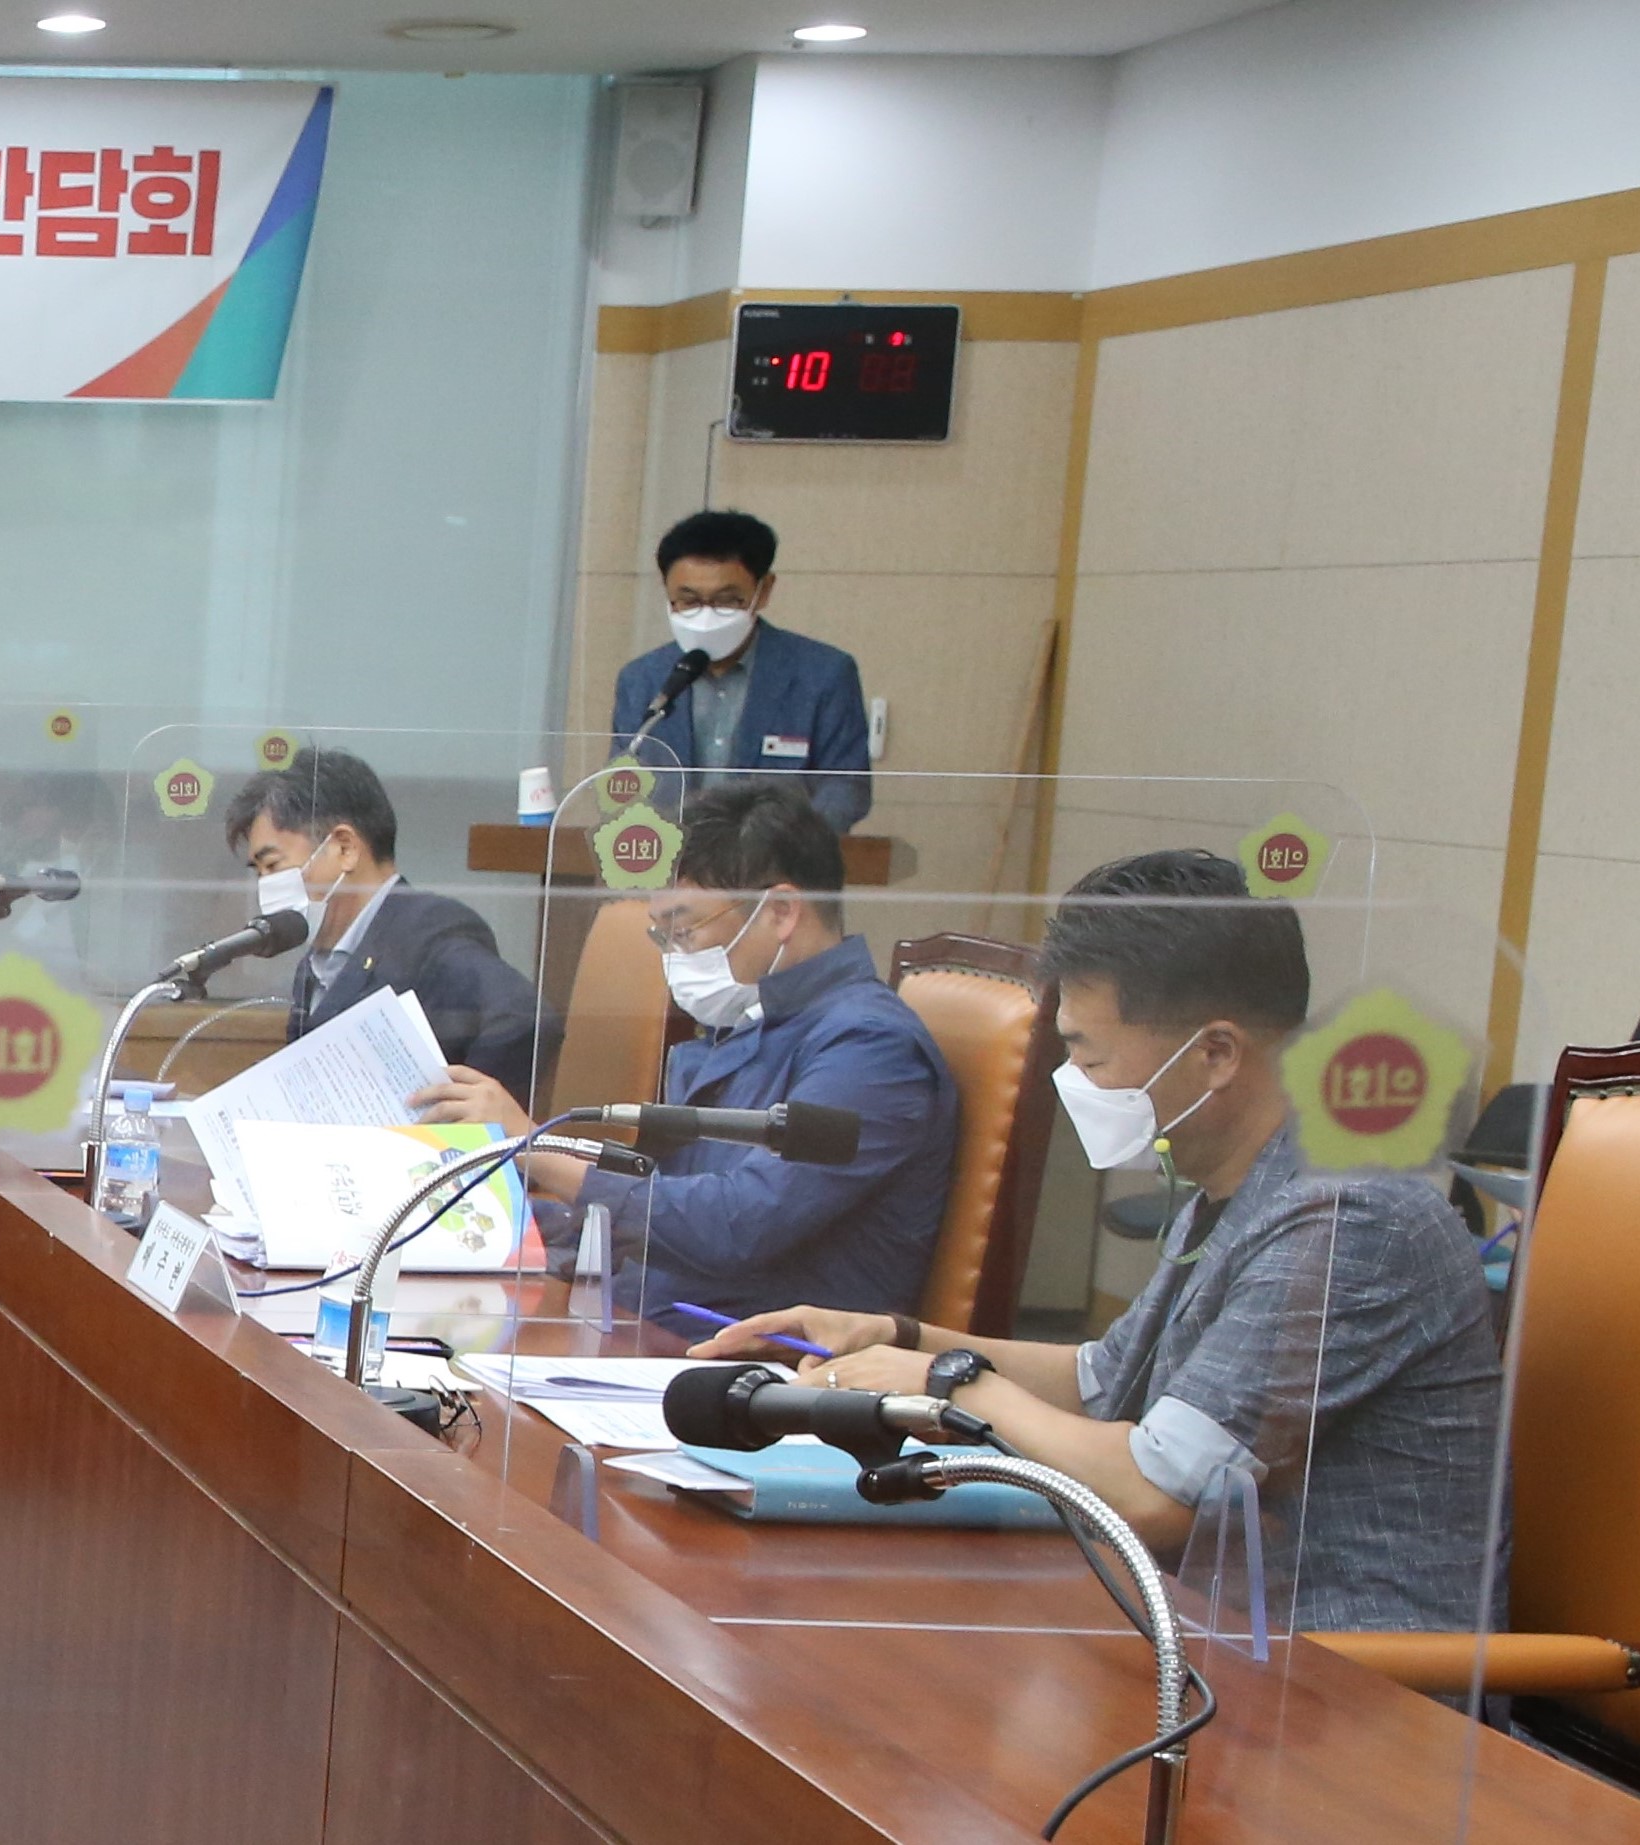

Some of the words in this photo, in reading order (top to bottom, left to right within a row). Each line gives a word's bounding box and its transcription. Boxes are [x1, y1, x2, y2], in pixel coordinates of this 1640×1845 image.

[785, 350, 833, 391] 10
[169, 780, 199, 797] 의회
[614, 837, 659, 862] 의회
